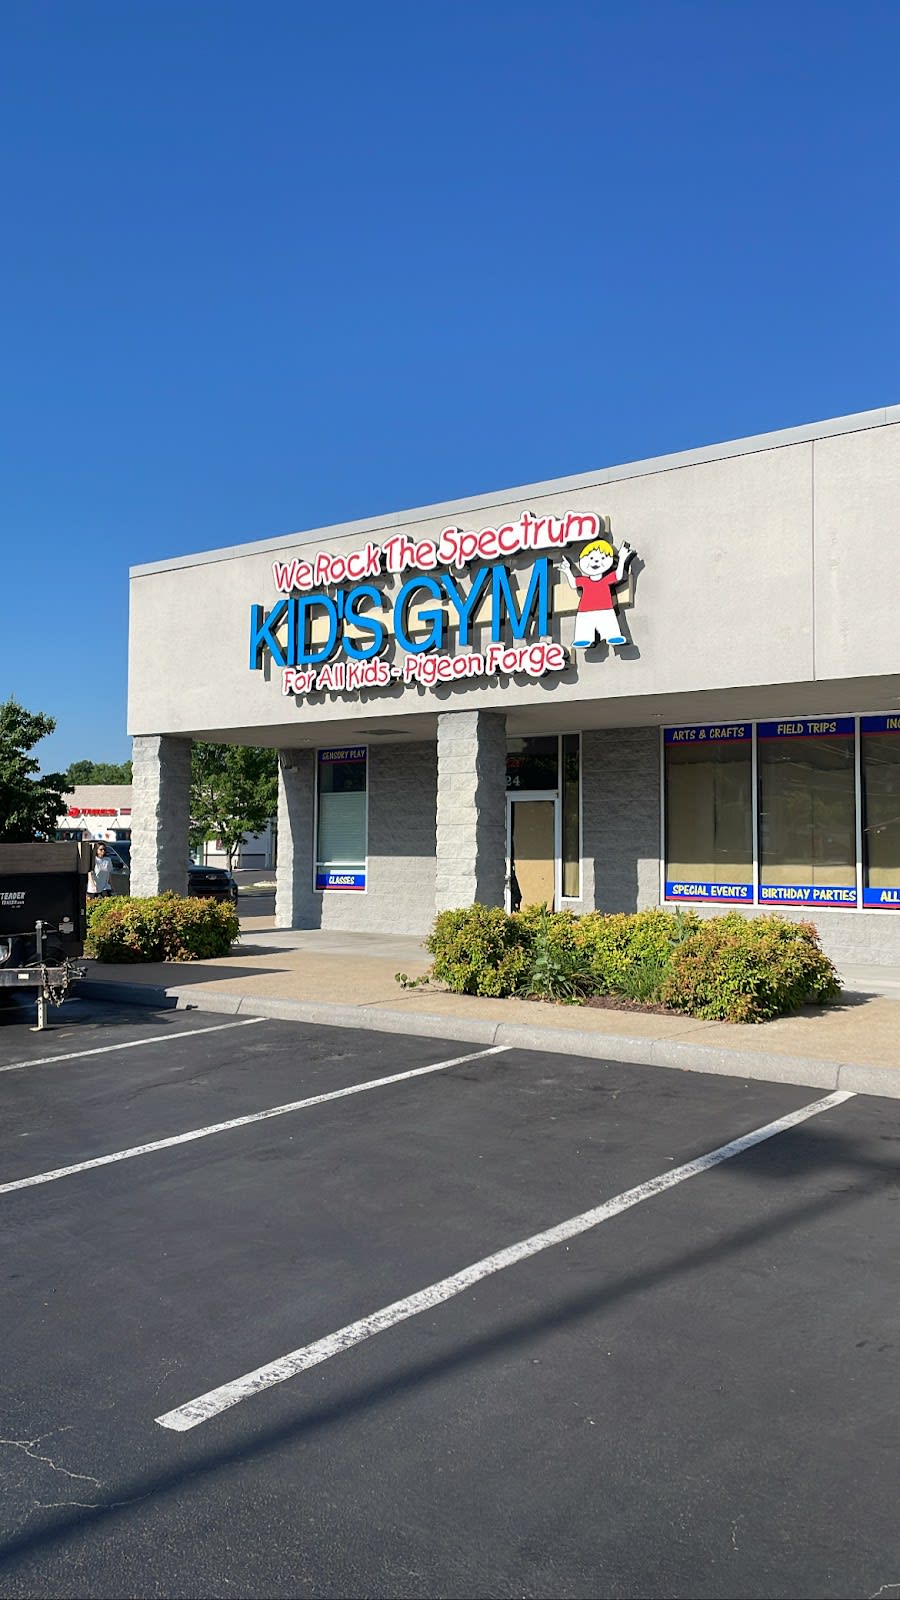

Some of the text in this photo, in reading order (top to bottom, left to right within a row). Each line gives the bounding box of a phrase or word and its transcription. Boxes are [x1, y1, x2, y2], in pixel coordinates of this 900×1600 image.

[274, 513, 597, 592] We Rock The Spectrum
[249, 557, 553, 670] KID'S GYM
[284, 668, 312, 692] For
[317, 664, 344, 690] All
[348, 662, 389, 690] Kids
[403, 656, 482, 687] Pigeon
[488, 644, 563, 681] Forge
[777, 721, 837, 735] FIELD TRIPS
[886, 718, 900, 729] IN
[672, 727, 745, 741] ARTS & CRAFTS
[321, 749, 366, 760] SENSORY PLAY
[328, 875, 355, 885] CLASSES
[672, 884, 748, 898] SPECIAL EVENTS
[761, 888, 857, 901] BIRTHDAY PARTIES
[880, 890, 900, 902] ALL
